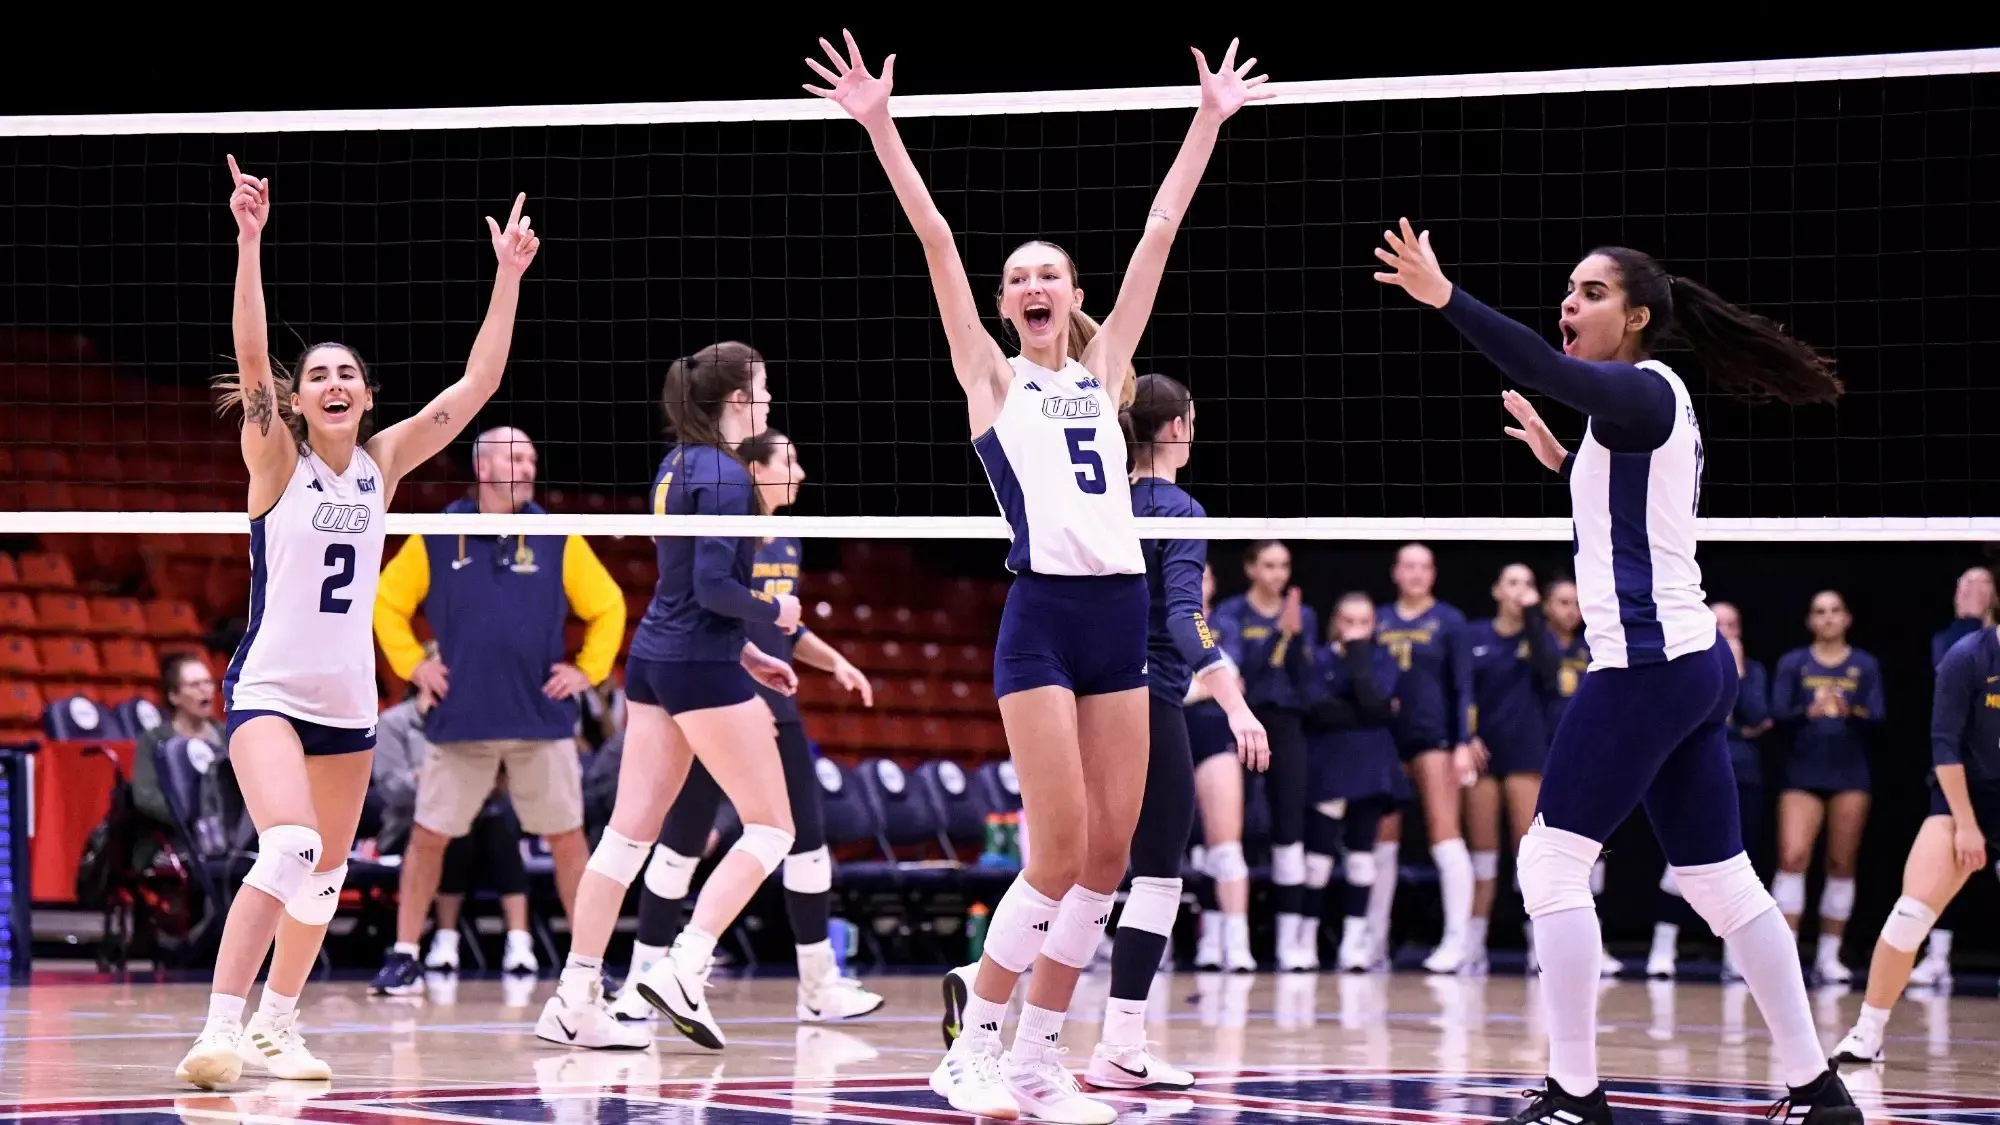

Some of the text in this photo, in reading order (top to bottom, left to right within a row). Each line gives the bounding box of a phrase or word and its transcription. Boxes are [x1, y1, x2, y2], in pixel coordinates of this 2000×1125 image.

[1042, 395, 1100, 419] UIC
[1064, 427, 1107, 495] 5
[312, 502, 370, 533] UIC
[319, 543, 356, 614] 2
